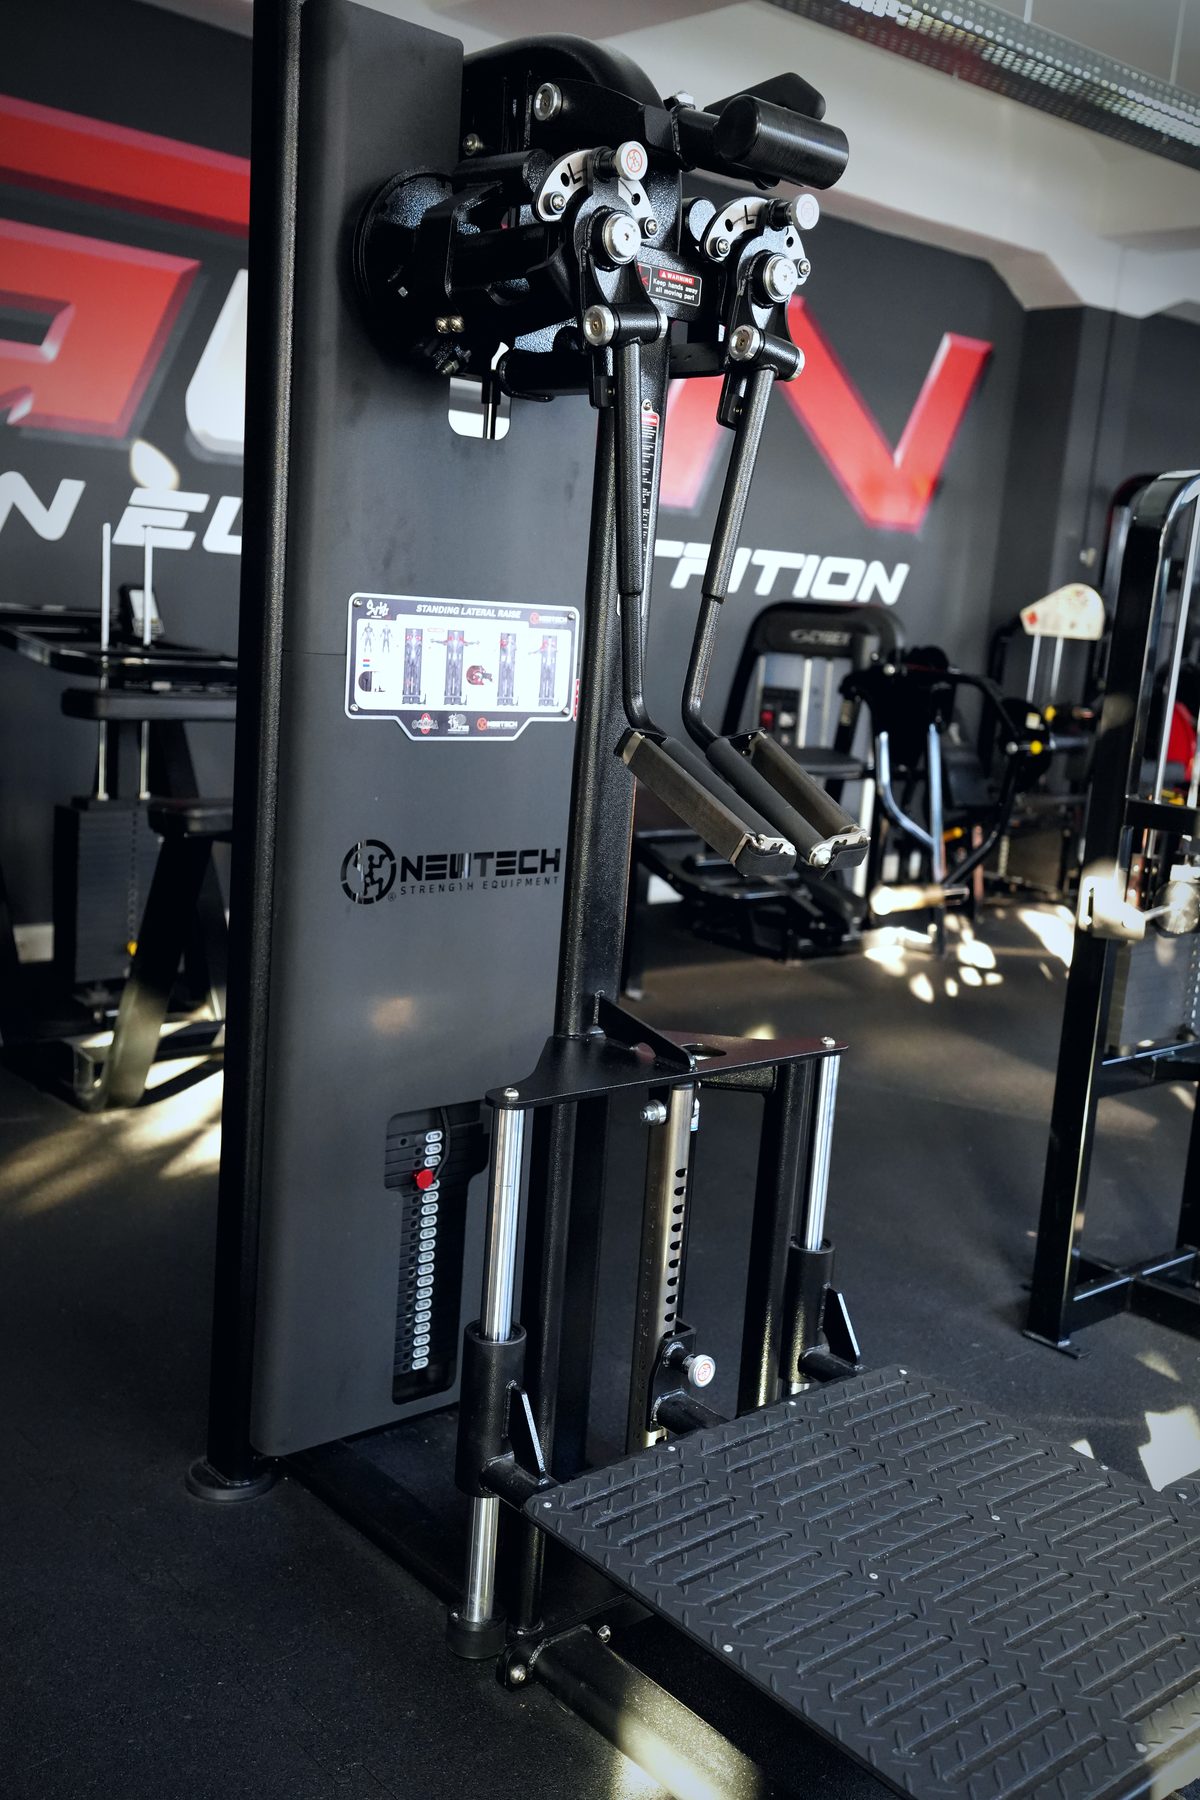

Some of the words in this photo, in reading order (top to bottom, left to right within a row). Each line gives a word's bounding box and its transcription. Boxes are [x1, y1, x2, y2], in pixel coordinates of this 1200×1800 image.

[653, 278, 666, 287] Keep
[668, 281, 683, 290] hands
[686, 287, 698, 295] away
[667, 273, 693, 284] WARNING
[664, 289, 682, 298] moving
[684, 293, 695, 301] part
[416, 603, 459, 615] STANDING
[460, 606, 496, 617] LATERAL
[497, 608, 522, 619] RAISE
[401, 848, 561, 882] NEWTECH
[401, 883, 474, 895] STRENGTH
[482, 876, 559, 890] EQUIPMENT
